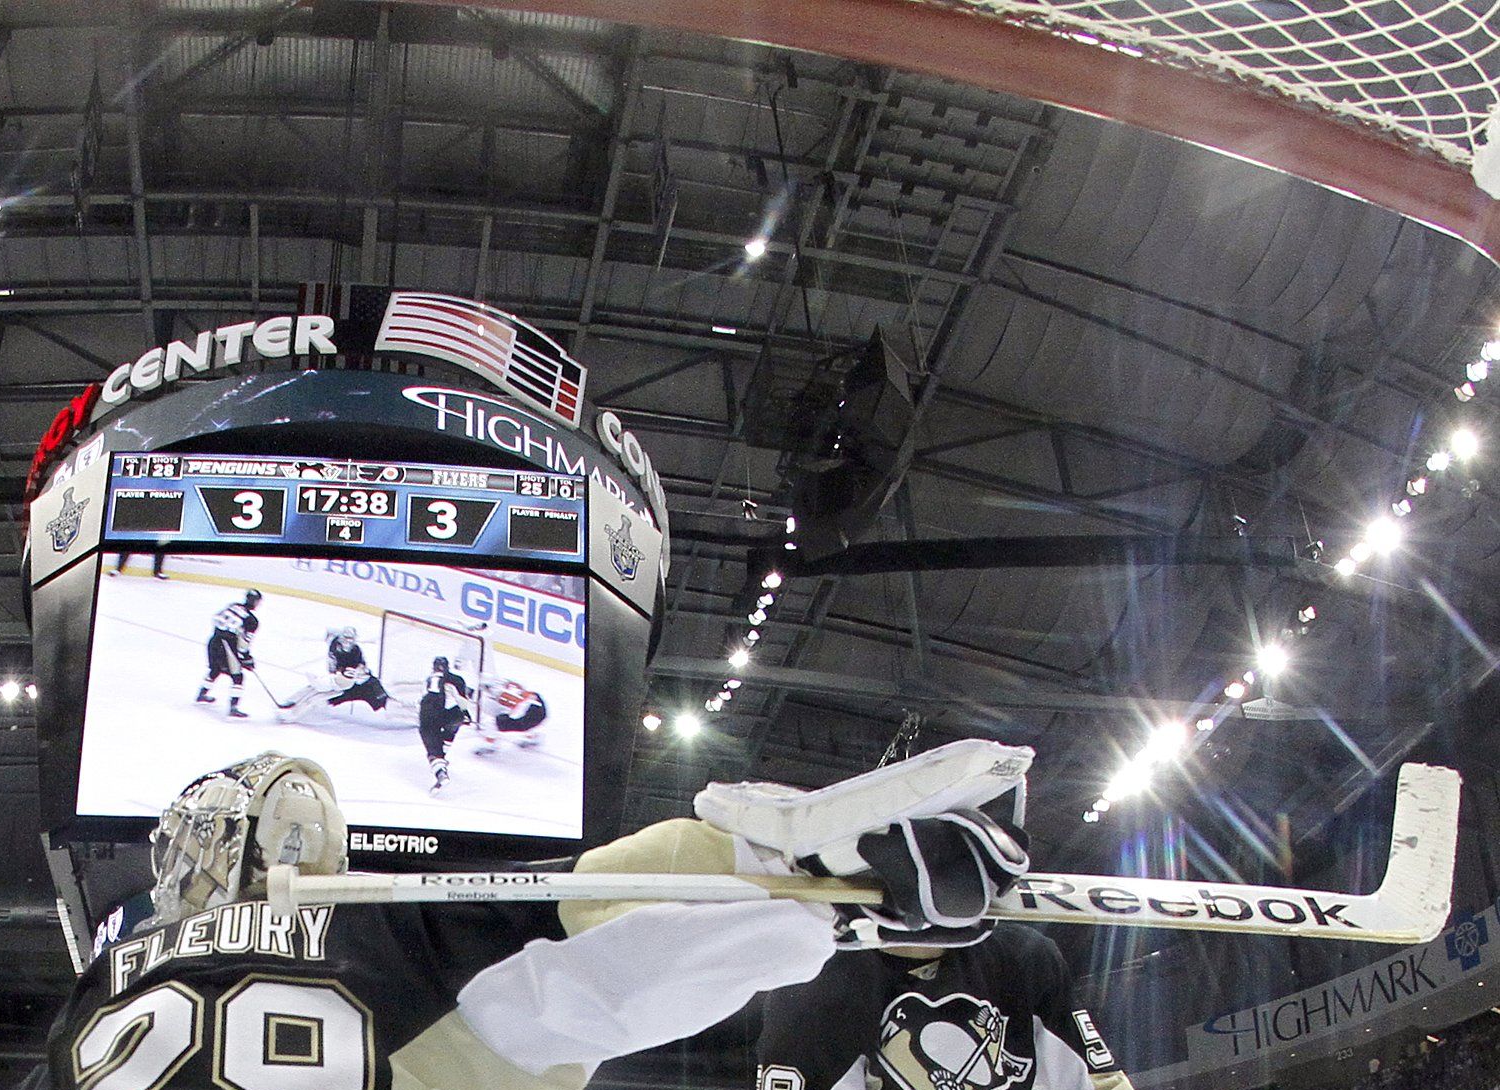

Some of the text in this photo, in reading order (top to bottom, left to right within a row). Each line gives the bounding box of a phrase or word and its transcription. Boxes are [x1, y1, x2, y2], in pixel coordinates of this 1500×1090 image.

[101, 314, 338, 405] CENTER
[126, 464, 175, 477] 1 28
[188, 460, 277, 476] PENGUINS
[432, 469, 489, 488] FLYERS
[519, 474, 546, 483] SHOTS
[117, 491, 183, 499] PLAYER PENALTY
[520, 483, 571, 498] 25 0
[230, 491, 265, 530] 3
[302, 489, 389, 514] 17:38
[330, 519, 362, 528] PERIOD
[425, 501, 459, 540] 3
[512, 508, 578, 521] PLAYER PENALTY
[338, 527, 351, 540] 4
[324, 559, 446, 601] HONDA
[460, 581, 584, 647] GEIC
[350, 832, 439, 854] ELECTRIC
[420, 874, 551, 886] Reebok
[447, 891, 498, 900] Reebok
[1013, 878, 1363, 929] Reebok
[110, 902, 336, 999] FLEURY
[1203, 948, 1438, 1056] HIGHMARK
[1071, 1009, 1115, 1070] 5
